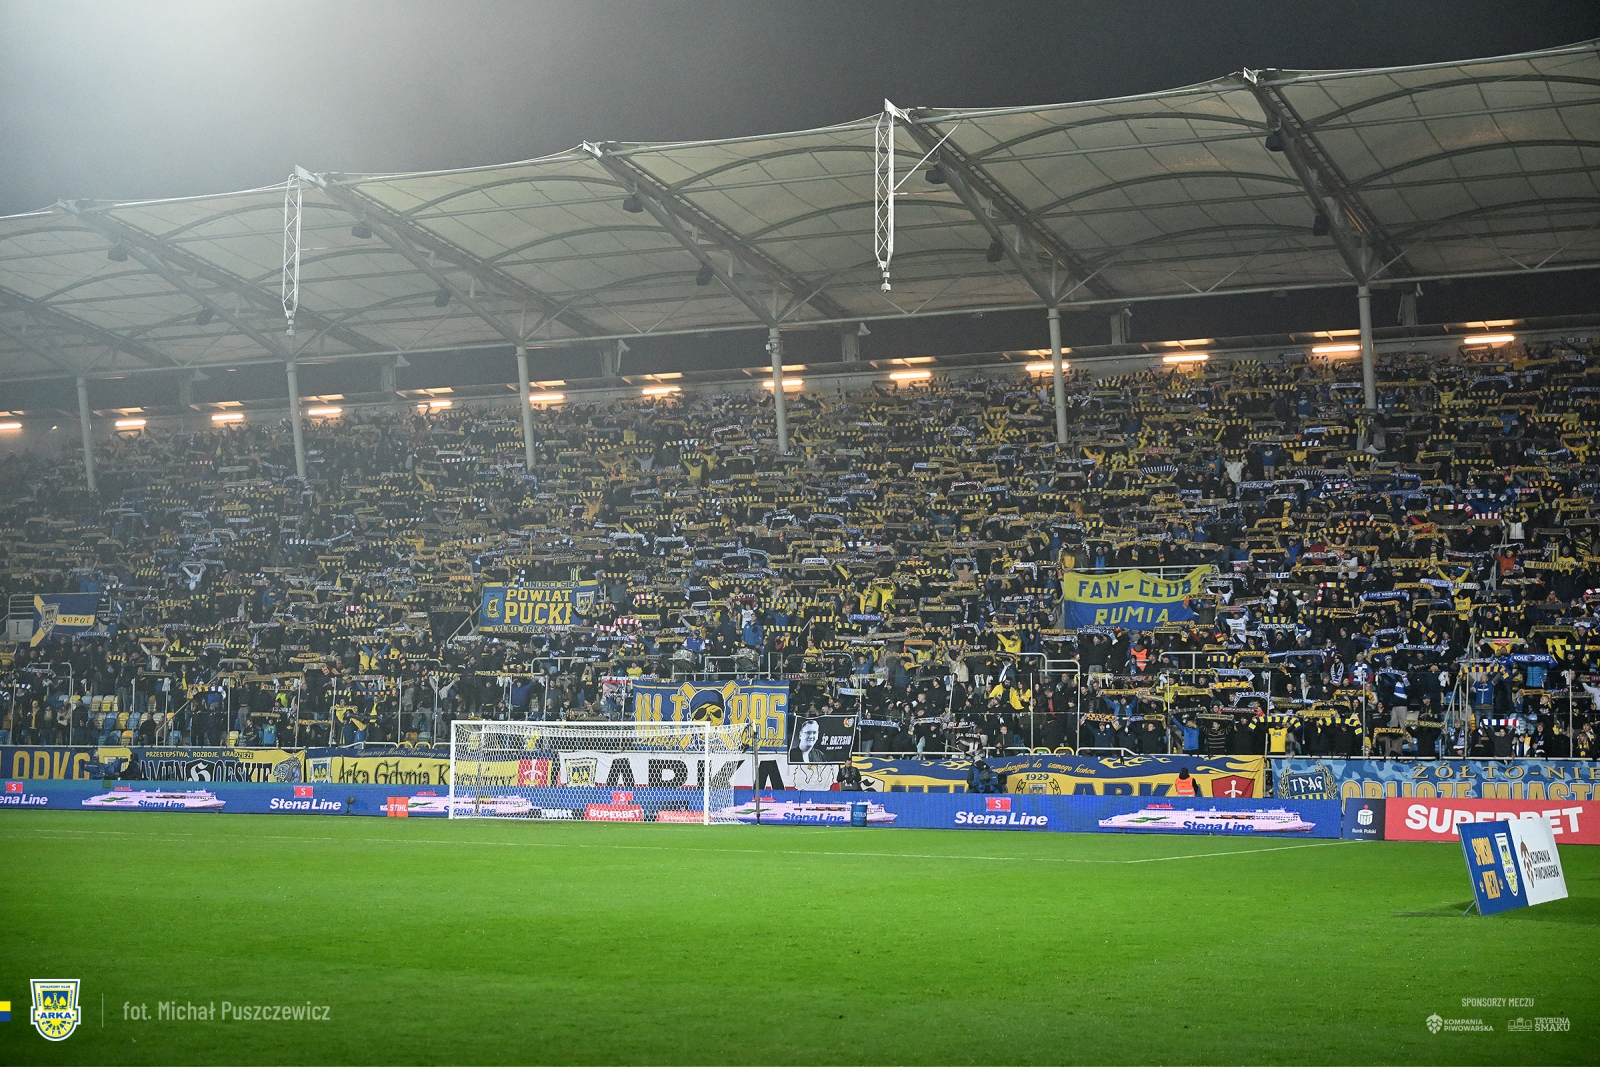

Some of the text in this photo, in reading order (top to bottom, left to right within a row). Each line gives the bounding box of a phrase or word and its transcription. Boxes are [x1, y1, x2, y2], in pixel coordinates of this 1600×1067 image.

[1078, 579, 1193, 598] FAN-CLUB
[505, 589, 573, 602] POWIAT
[61, 616, 92, 624] SOPOT
[1094, 606, 1170, 625] RUMIA
[490, 625, 519, 634] TYLKO
[521, 625, 546, 633] ARKA
[1025, 773, 1050, 781] 1929
[1289, 775, 1323, 792] TPAG
[0, 794, 48, 805] ena Line
[137, 799, 186, 808] Stena Line
[269, 798, 342, 810] Stena Line
[994, 799, 1002, 809] S
[389, 803, 408, 812] STIHL
[589, 809, 641, 819] SUPERBET
[782, 812, 815, 822] Stena
[815, 813, 845, 822] Line
[954, 811, 1048, 826] Stena Line
[1182, 820, 1223, 831] Stena
[1224, 821, 1255, 832] Line
